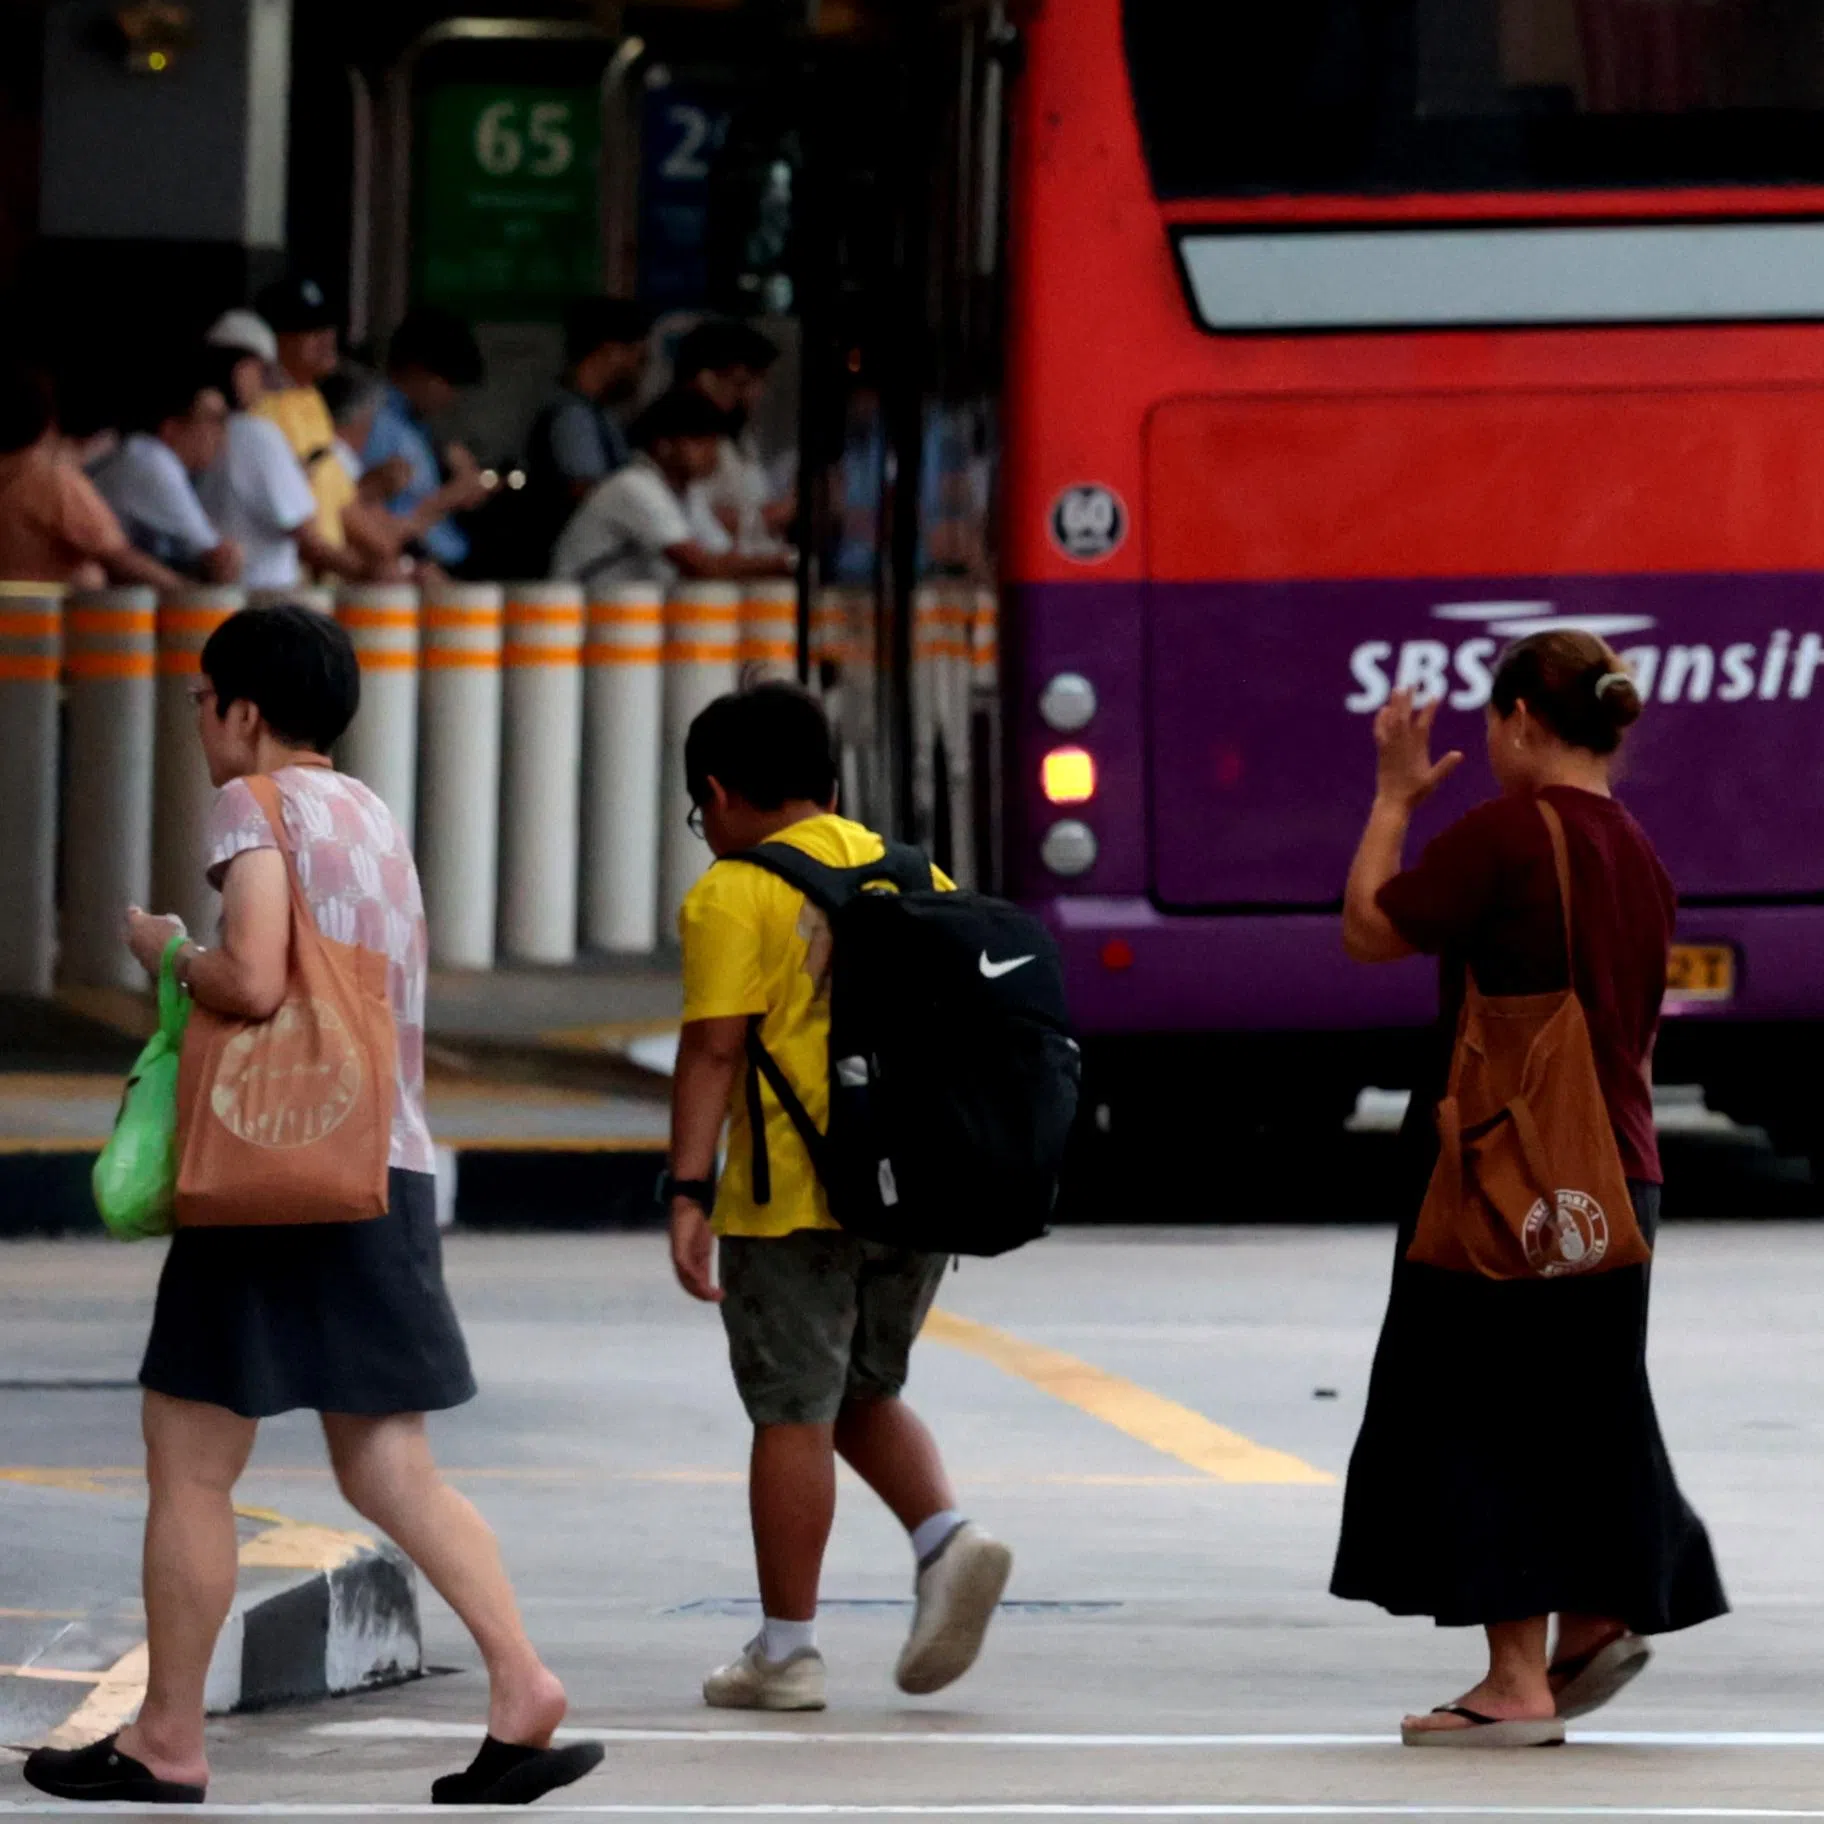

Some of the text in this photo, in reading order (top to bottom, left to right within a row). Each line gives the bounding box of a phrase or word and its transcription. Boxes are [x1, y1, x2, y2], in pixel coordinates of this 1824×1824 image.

[476, 101, 574, 176] 65
[661, 104, 732, 180] 2
[1345, 637, 1497, 714] SBS
